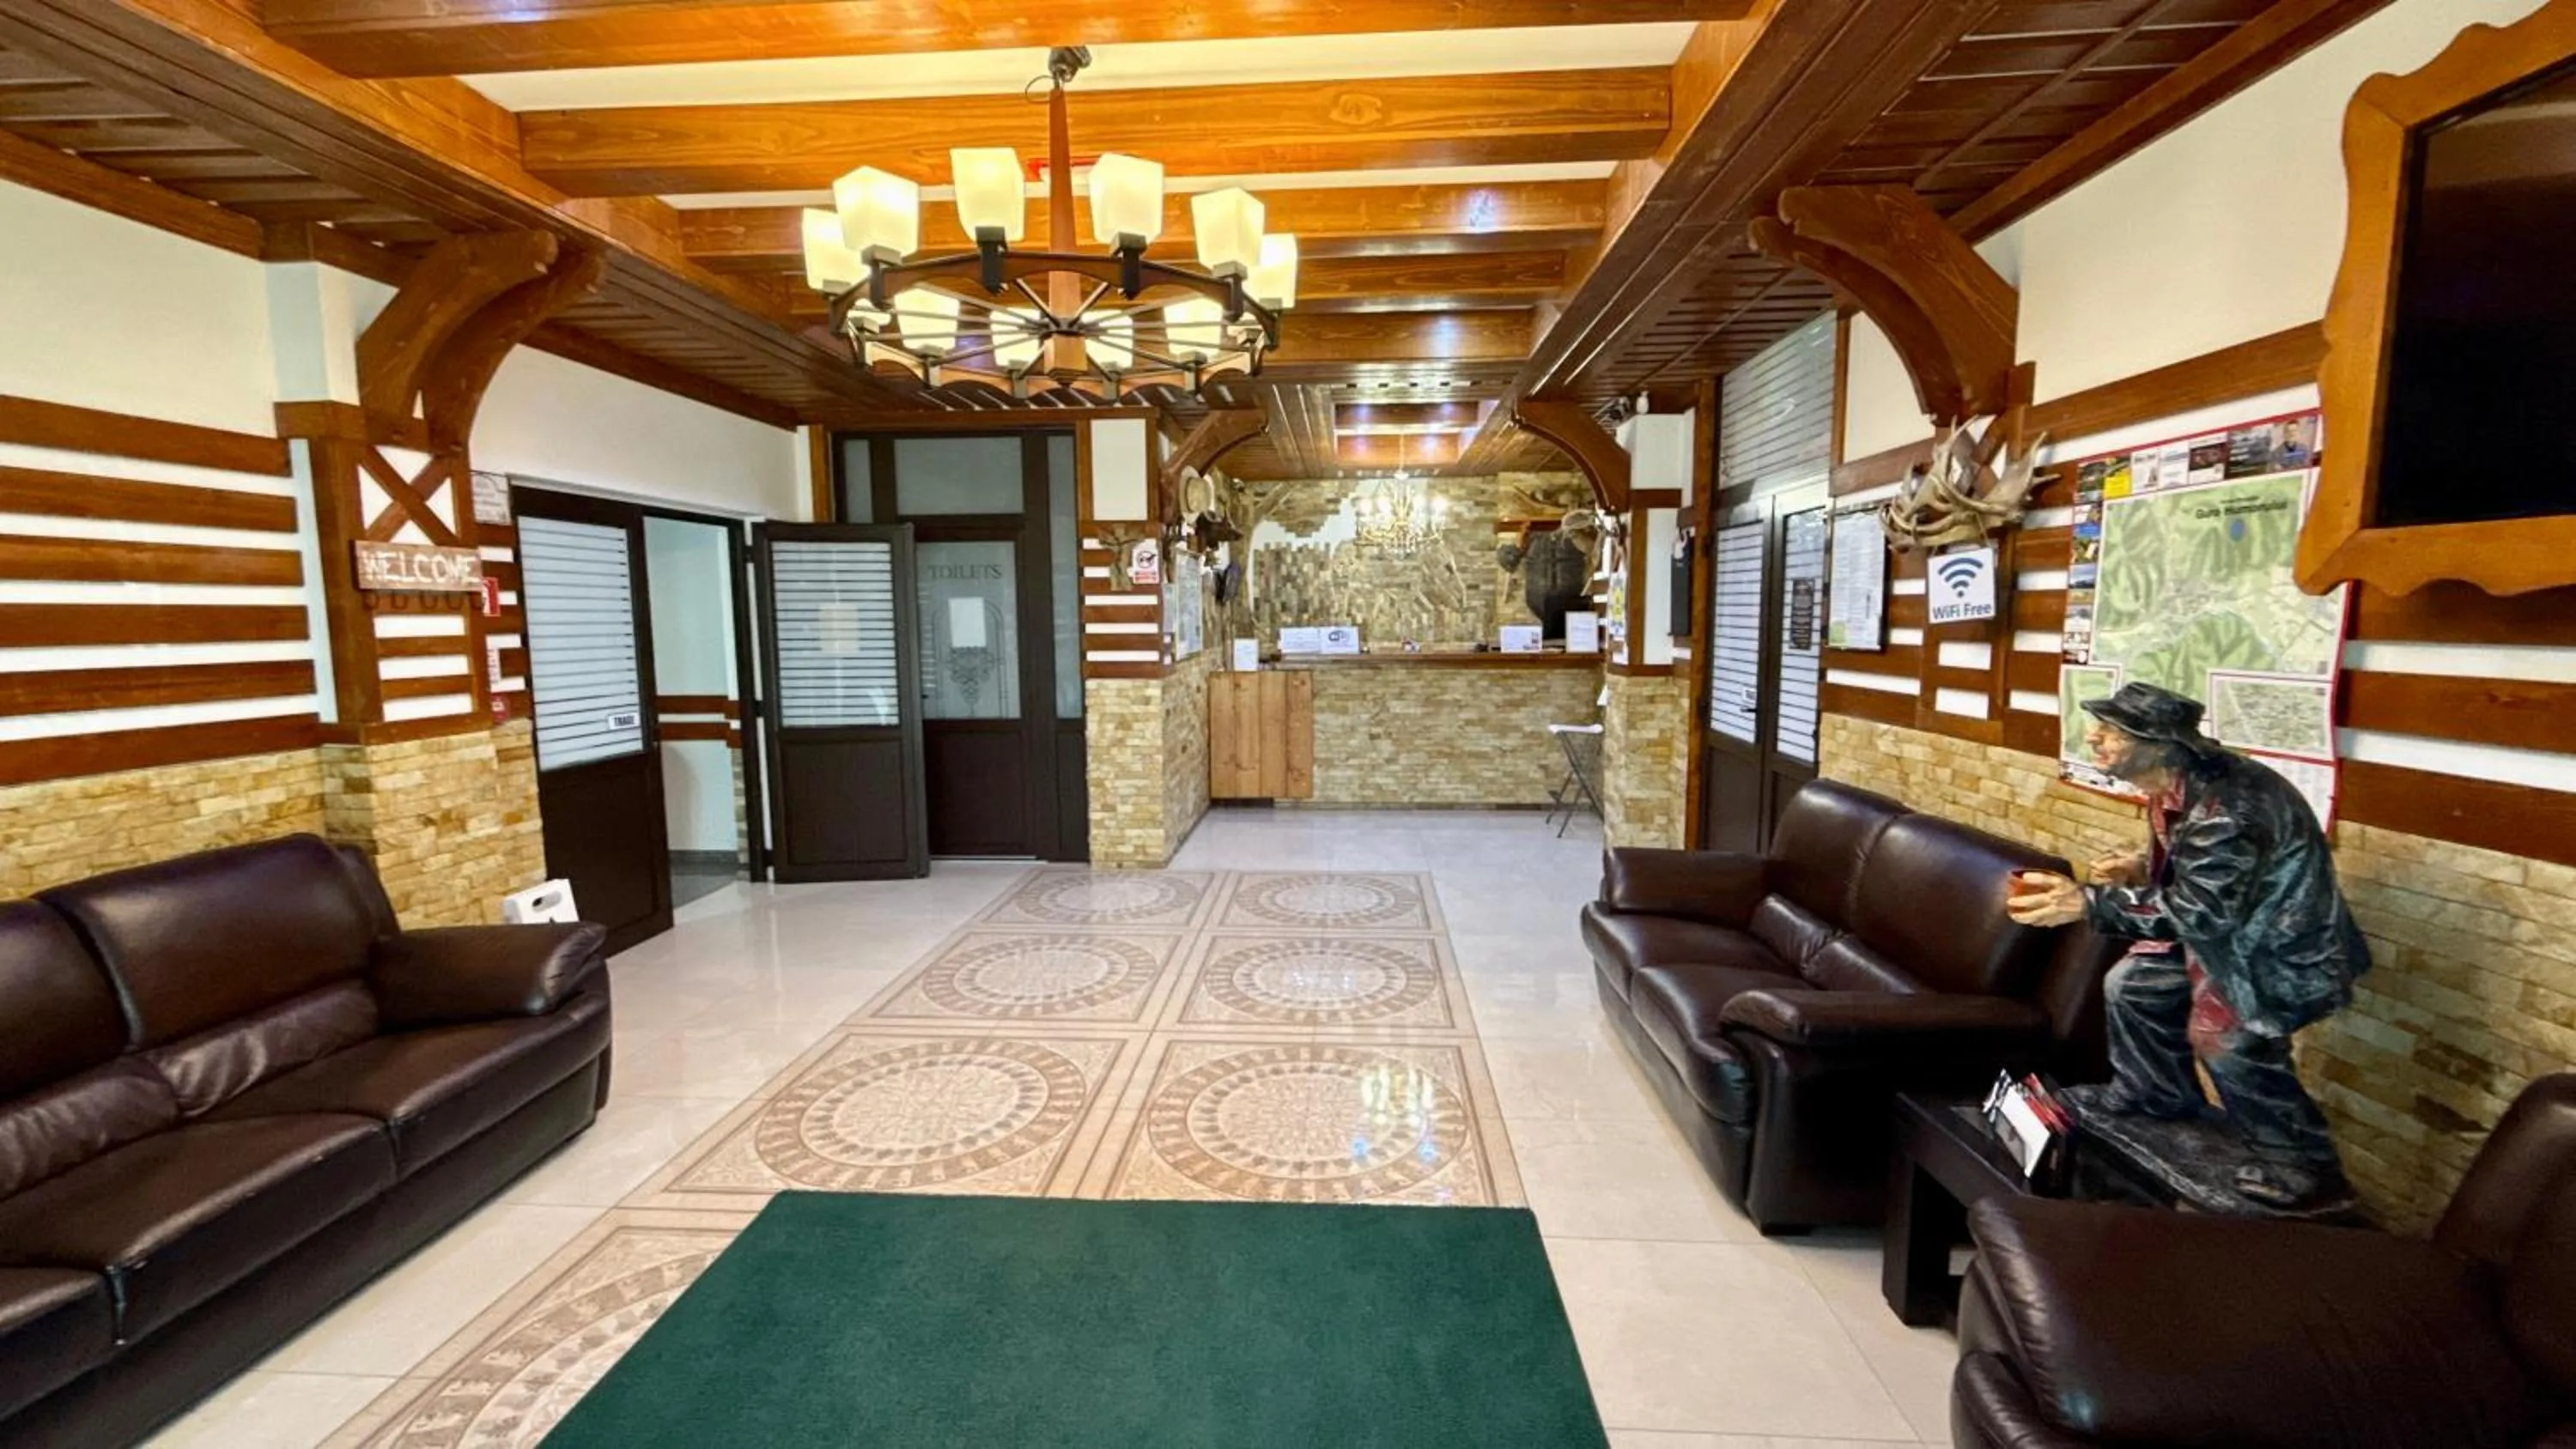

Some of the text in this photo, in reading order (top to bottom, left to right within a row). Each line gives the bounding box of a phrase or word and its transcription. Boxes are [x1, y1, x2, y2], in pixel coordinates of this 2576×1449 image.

[361, 551, 481, 584] WELCOME
[927, 563, 1003, 579] TOILETS
[1933, 603, 1992, 619] WiFi Free
